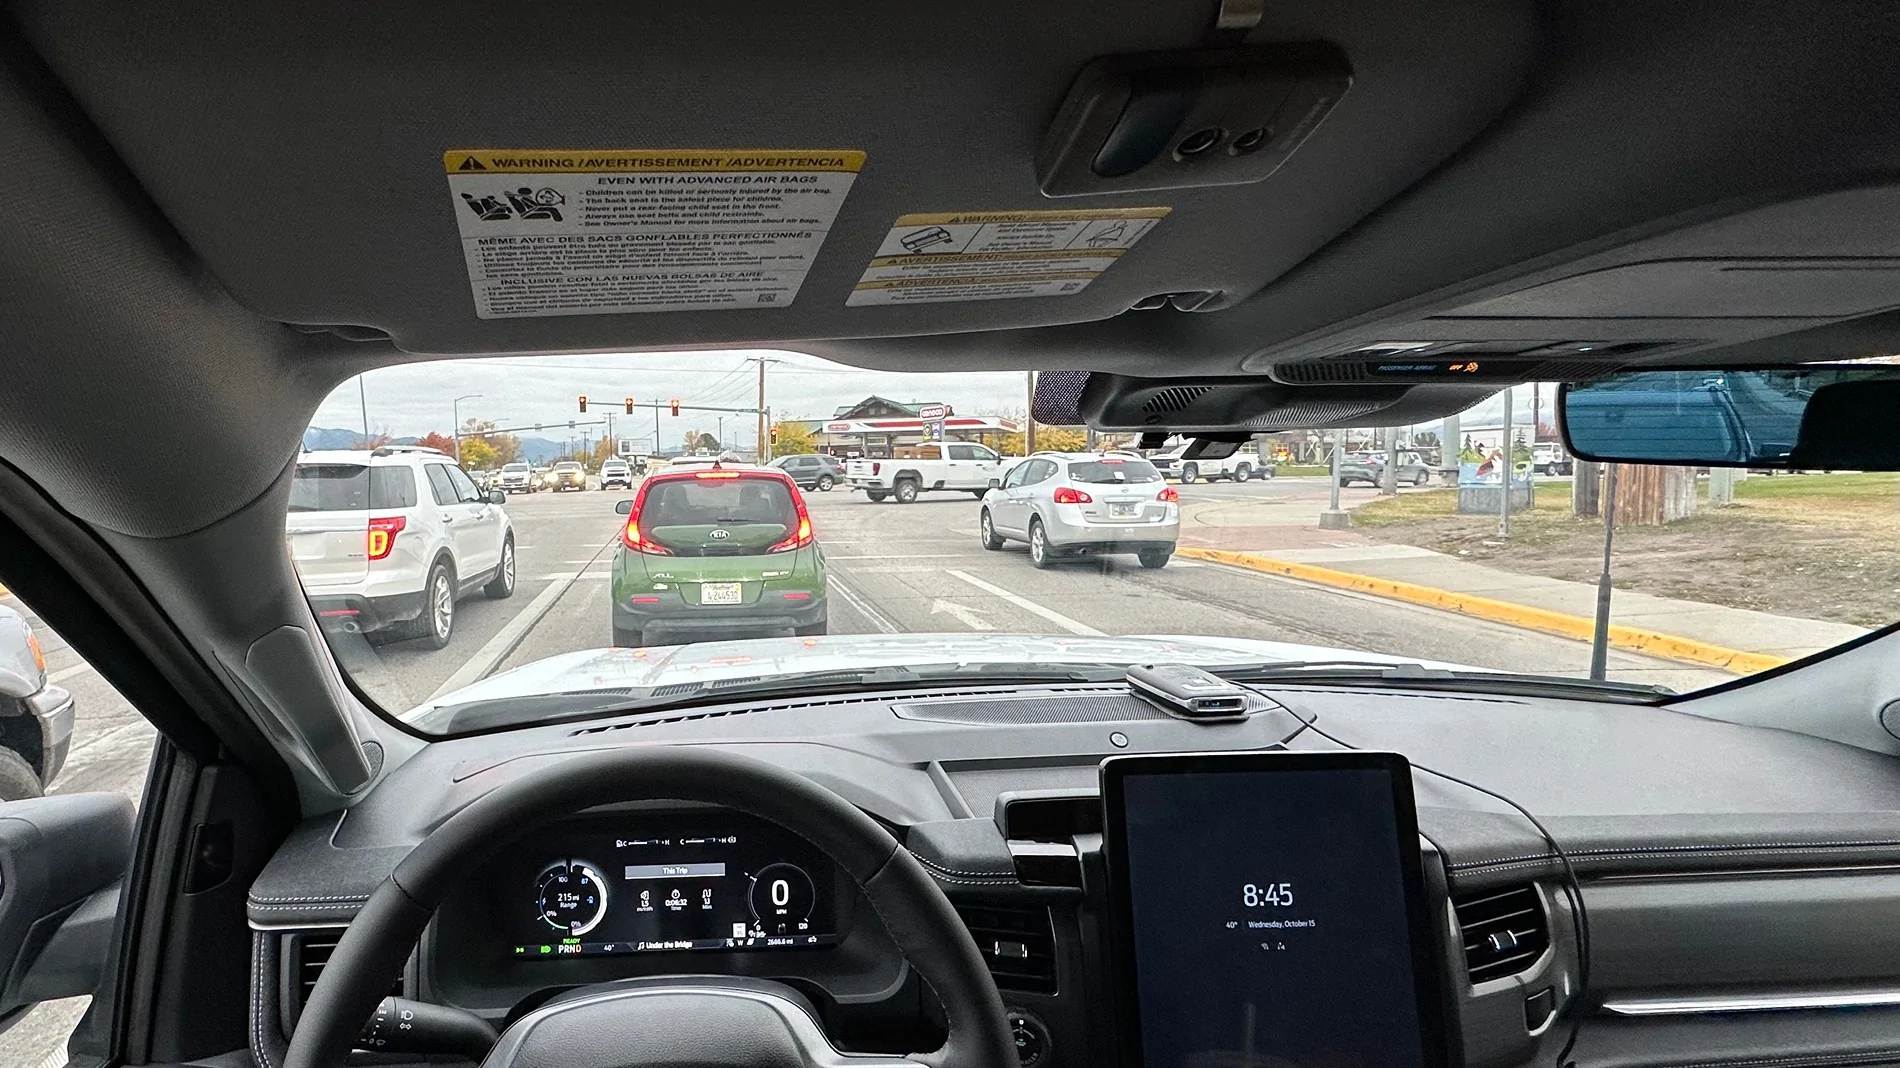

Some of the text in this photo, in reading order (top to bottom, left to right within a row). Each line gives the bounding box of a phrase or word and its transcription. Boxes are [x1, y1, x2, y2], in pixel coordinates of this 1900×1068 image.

[492, 158, 573, 168] WARNING
[598, 177, 635, 185] EVEN
[640, 176, 675, 184] WITH
[756, 176, 777, 184] AIR
[780, 176, 818, 184] BAGS
[478, 237, 517, 246] MÊME
[626, 234, 710, 242] GONFLABLES
[713, 232, 812, 240] PERFECTIONNÉS
[712, 530, 728, 538] KIA
[676, 866, 688, 874] Trip
[558, 893, 572, 902] 215
[772, 880, 789, 906] 0
[1243, 883, 1294, 907] 8:45
[1226, 921, 1238, 929] 40°
[1284, 920, 1308, 928] October
[1309, 920, 1316, 928] 15
[646, 940, 693, 950] Under the Bridge
